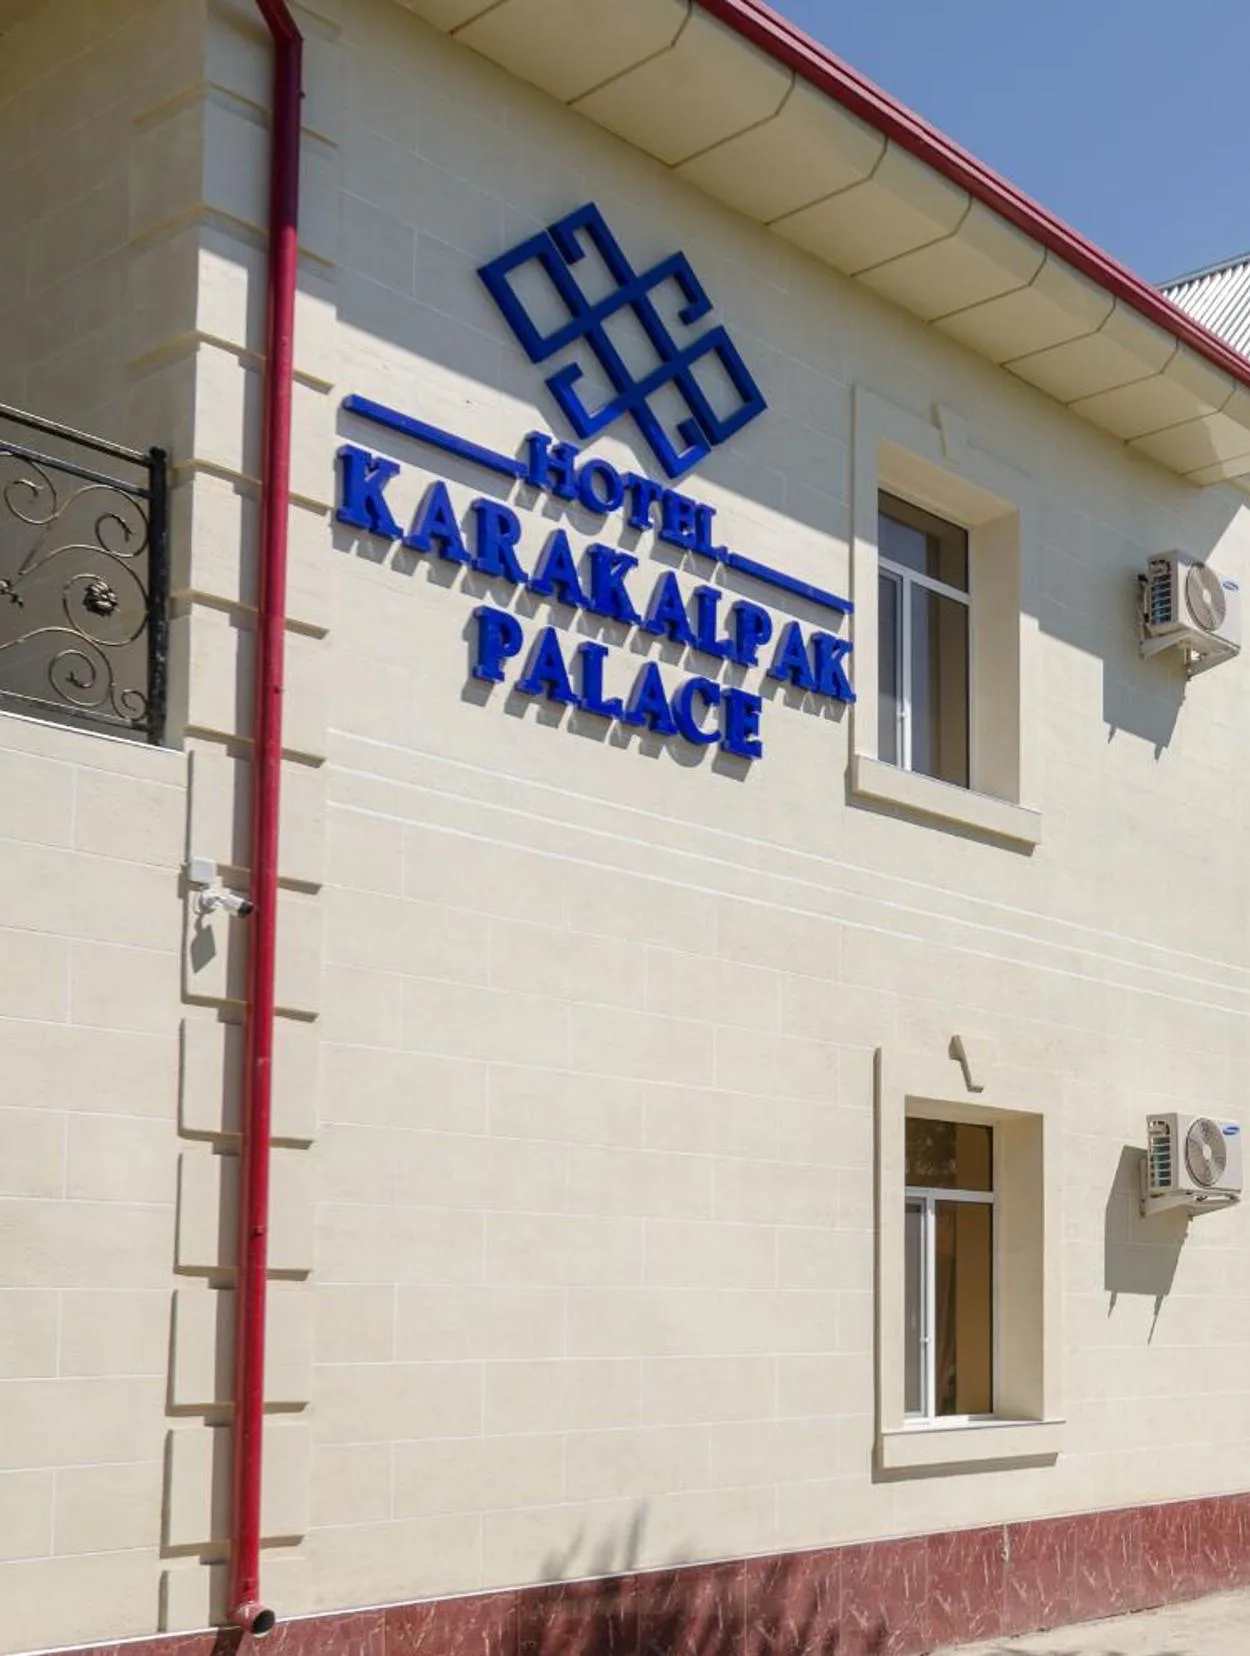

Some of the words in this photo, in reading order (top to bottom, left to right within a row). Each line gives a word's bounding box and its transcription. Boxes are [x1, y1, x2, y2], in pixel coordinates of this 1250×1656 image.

[336, 444, 856, 703] KARAKALPAK
[523, 430, 729, 562] HOTEL
[471, 605, 763, 760] PALACE
